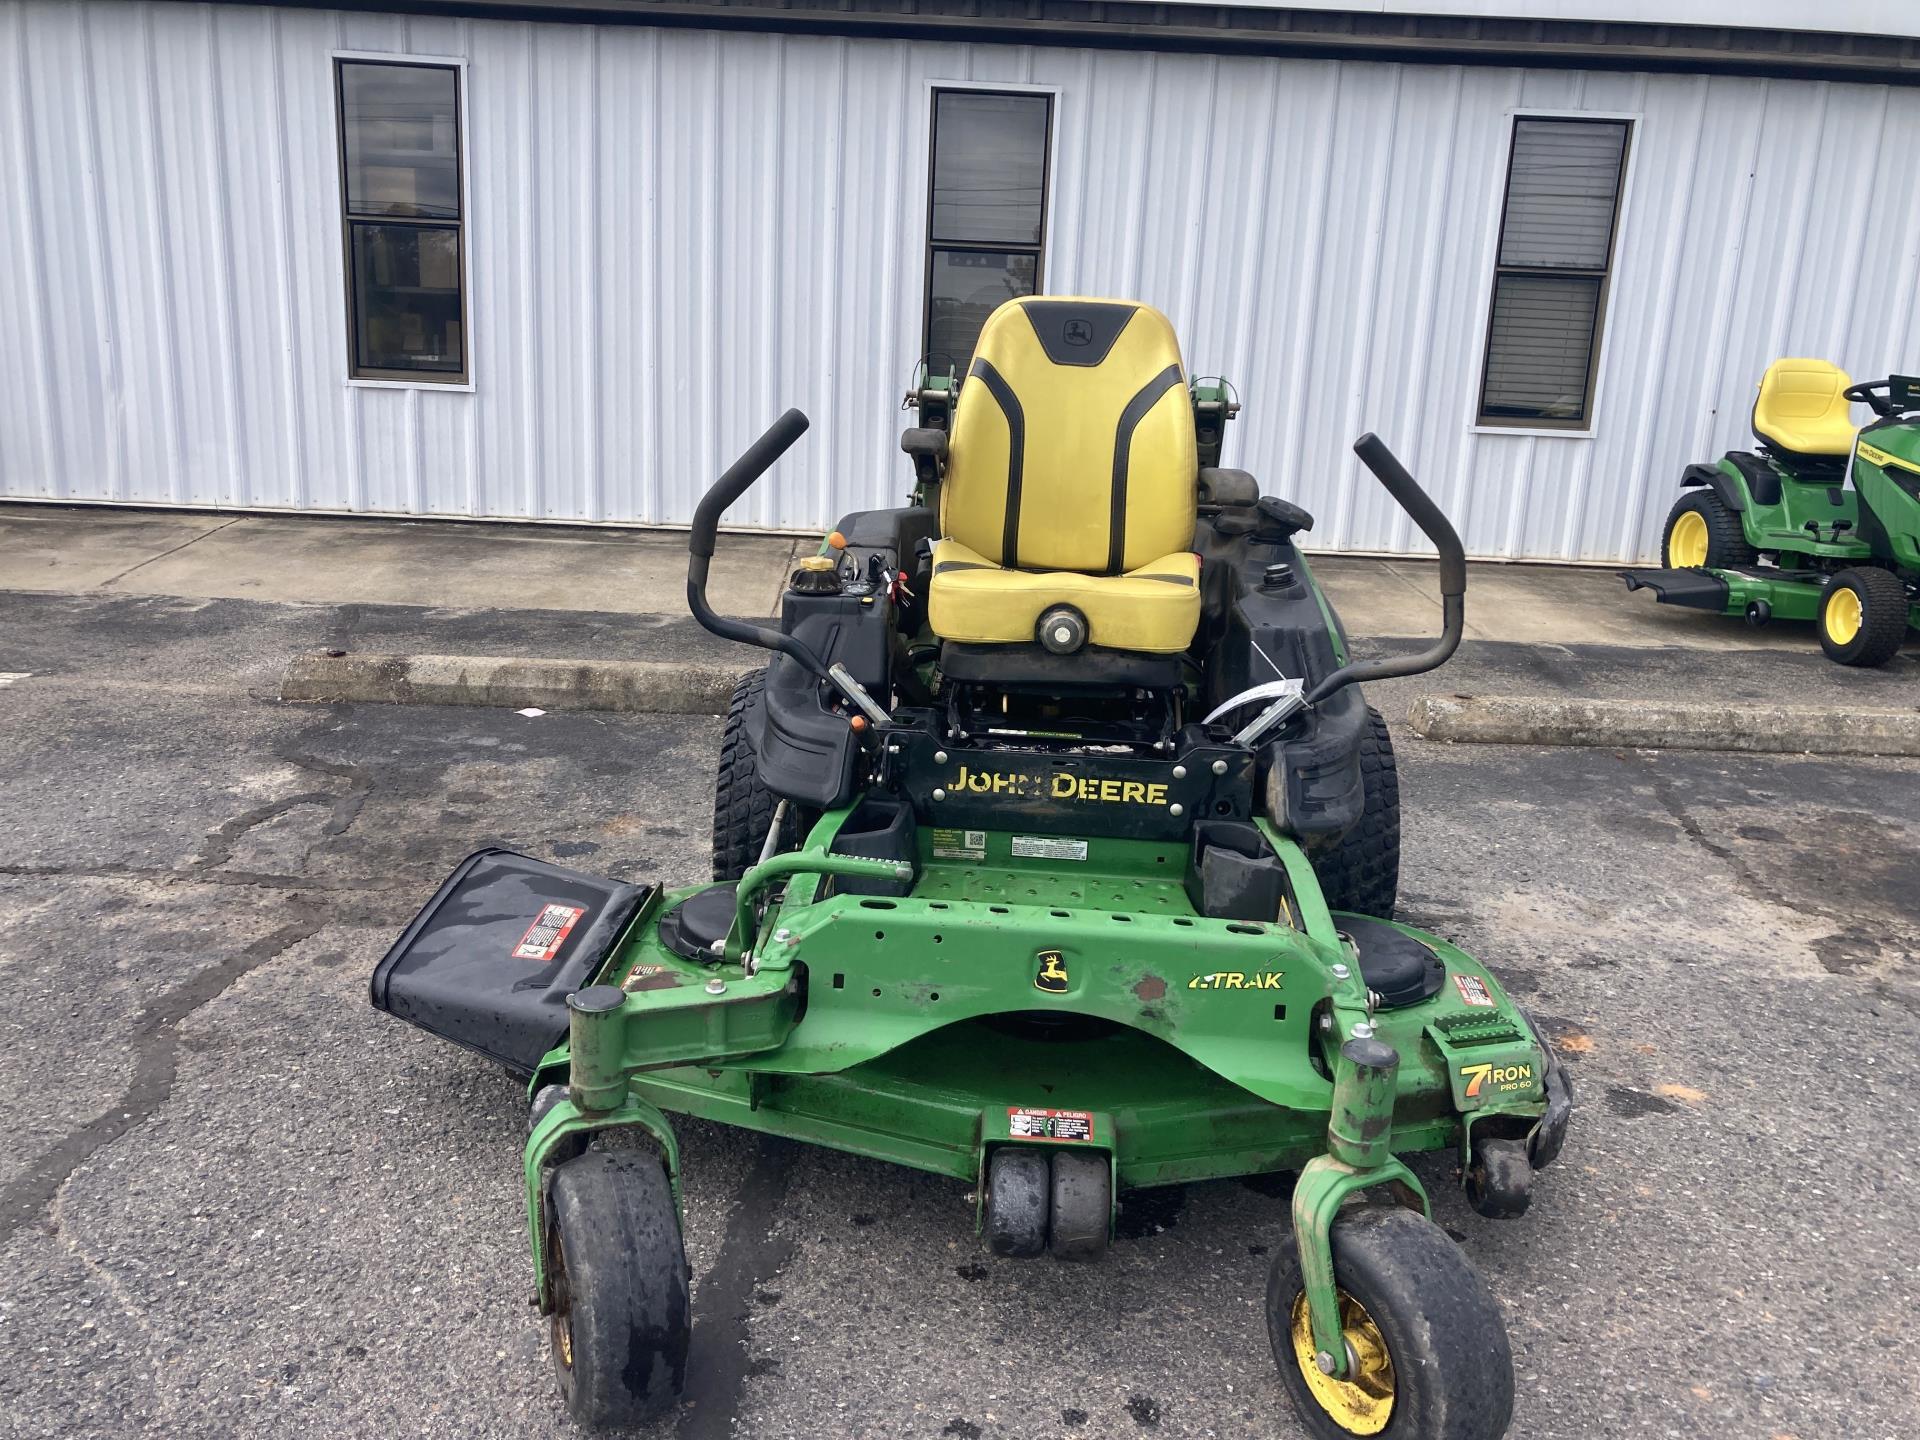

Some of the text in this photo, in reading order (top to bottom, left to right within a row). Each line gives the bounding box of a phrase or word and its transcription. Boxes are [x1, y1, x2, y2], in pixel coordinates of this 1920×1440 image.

[1051, 772, 1168, 804] DEERE
[1460, 1063, 1532, 1098] 7 IRON
[1500, 1080, 1532, 1092] PRO 60
